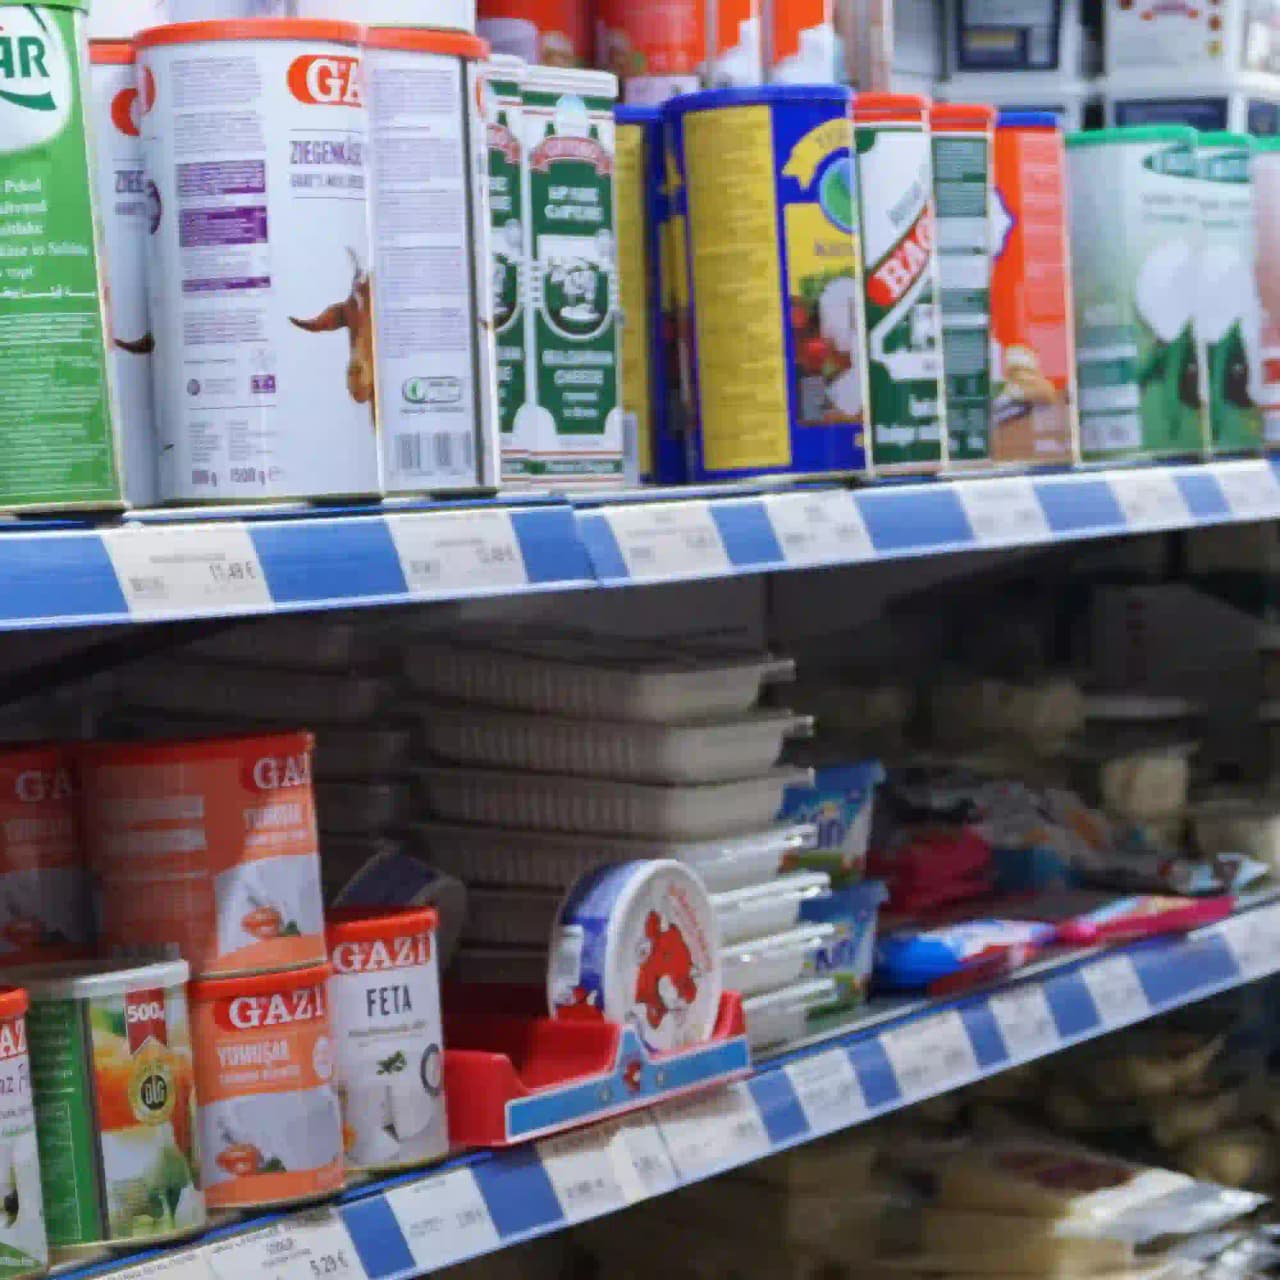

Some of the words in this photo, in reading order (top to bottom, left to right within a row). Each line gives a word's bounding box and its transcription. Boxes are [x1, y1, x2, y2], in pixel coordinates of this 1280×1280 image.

[332, 932, 431, 974] GAZI
[229, 984, 326, 1029] GAZI
[366, 984, 413, 1017] FETA
